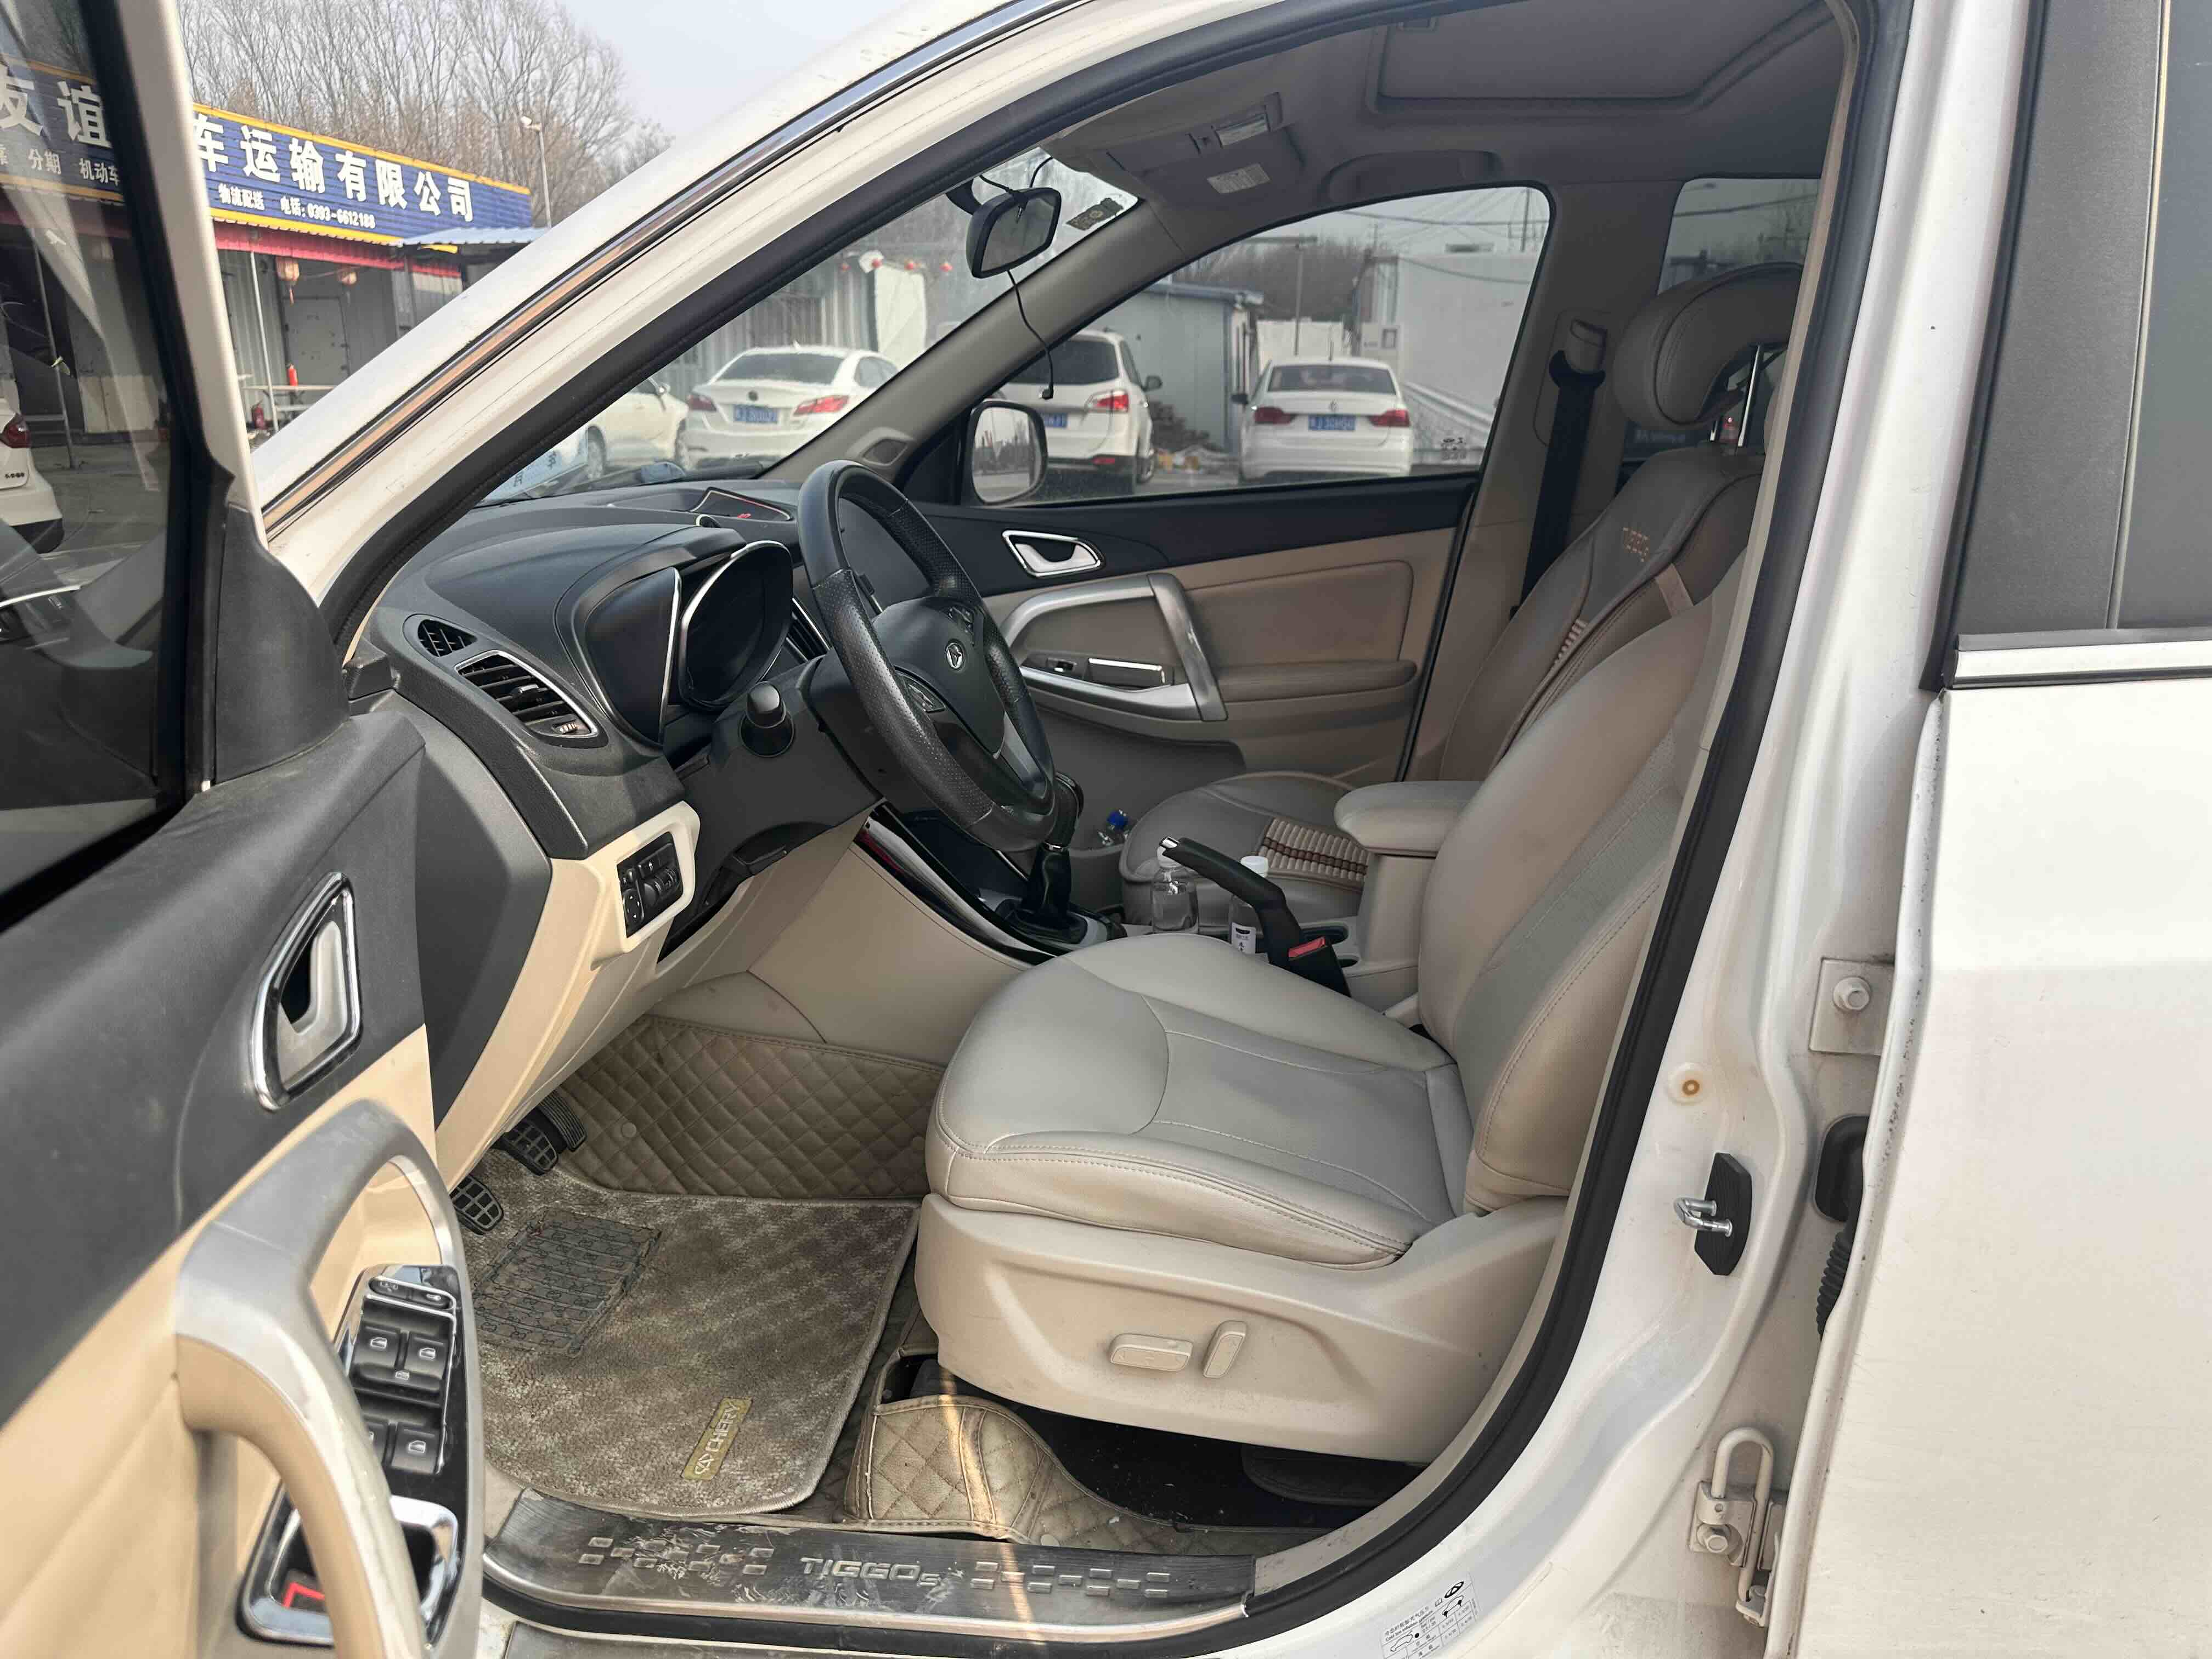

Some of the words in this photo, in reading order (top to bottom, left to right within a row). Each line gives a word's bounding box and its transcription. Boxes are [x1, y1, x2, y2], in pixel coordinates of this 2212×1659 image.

[29, 148, 61, 174] 分期
[79, 158, 120, 185] 机动车
[193, 114, 473, 222] 车运输有限公司
[706, 1402, 741, 1452] CHERY
